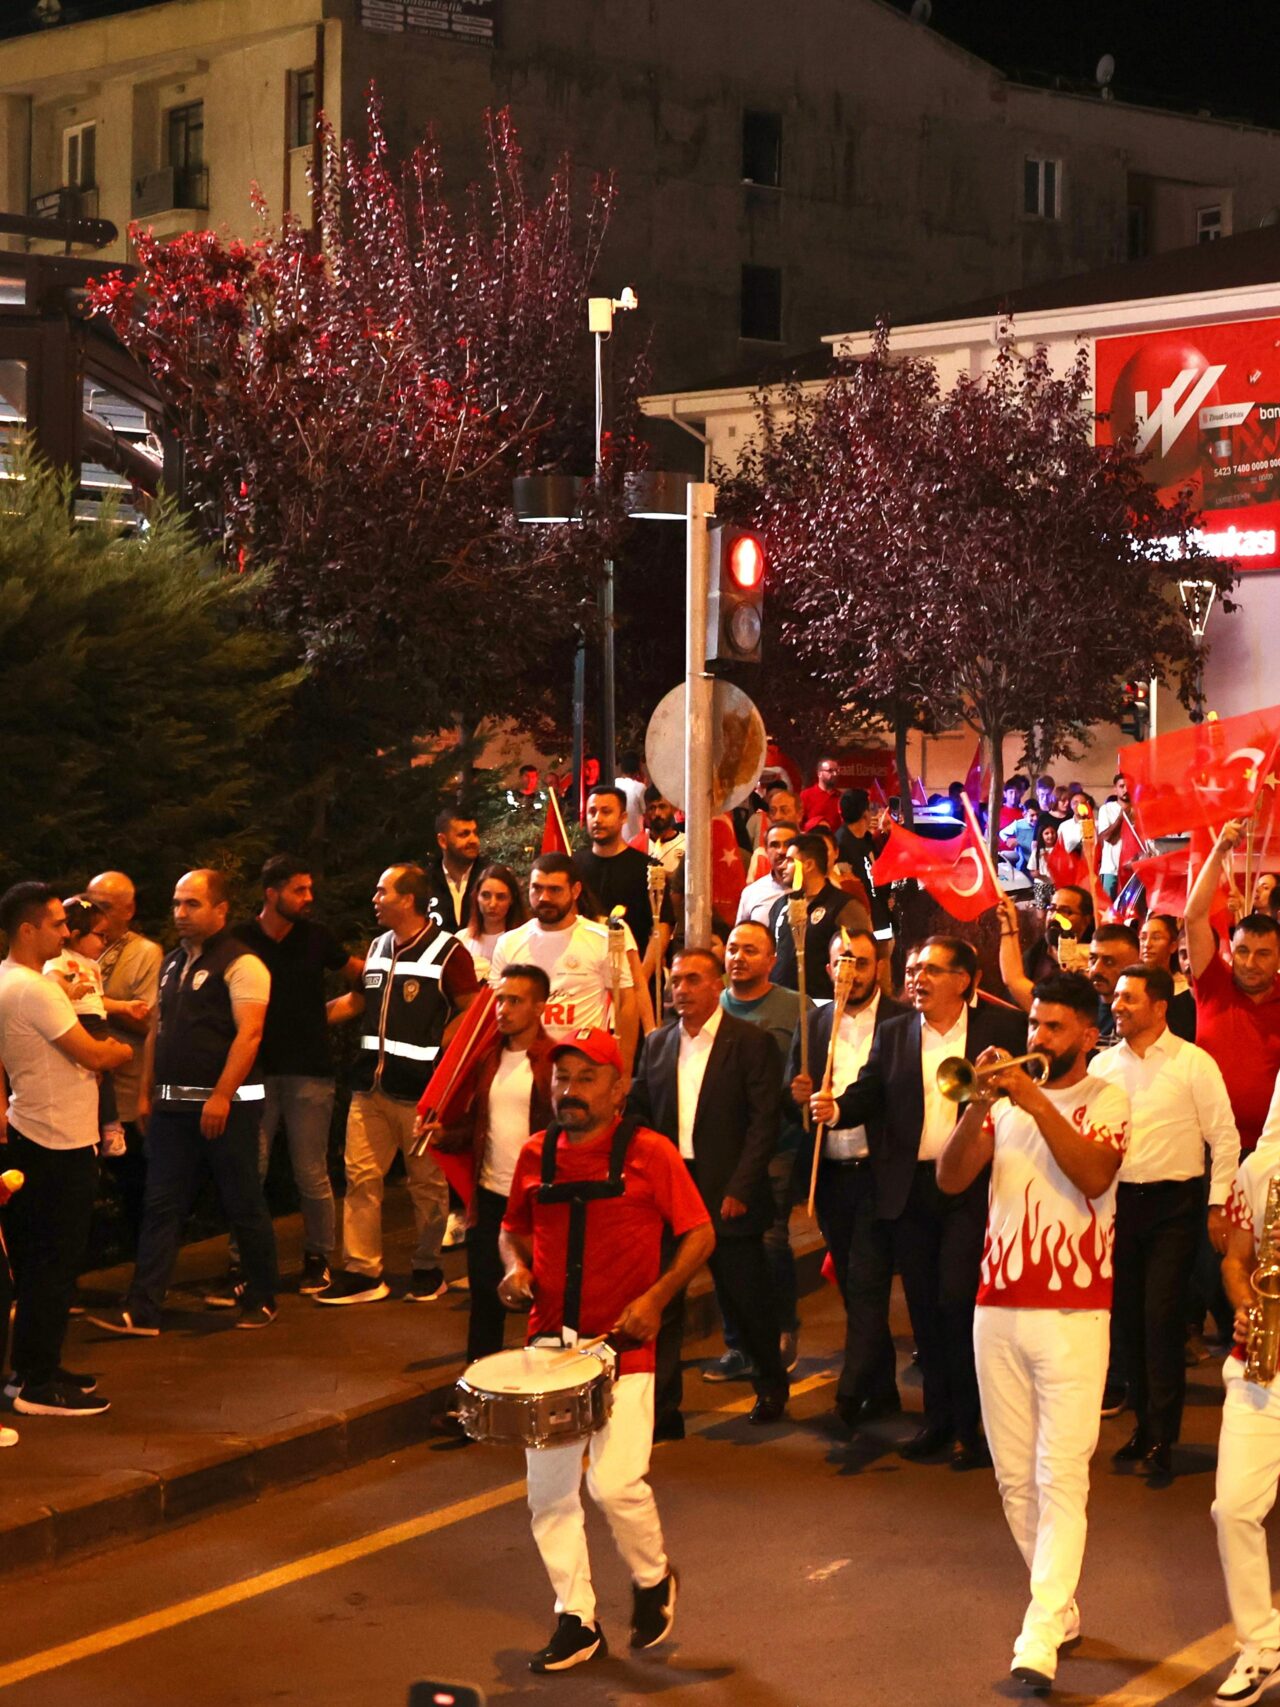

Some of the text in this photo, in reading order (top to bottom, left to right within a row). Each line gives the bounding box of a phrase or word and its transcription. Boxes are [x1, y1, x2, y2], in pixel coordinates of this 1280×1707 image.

[1214, 467, 1232, 478] 5423
[1251, 460, 1269, 471] 0000
[544, 1003, 576, 1026] RI
